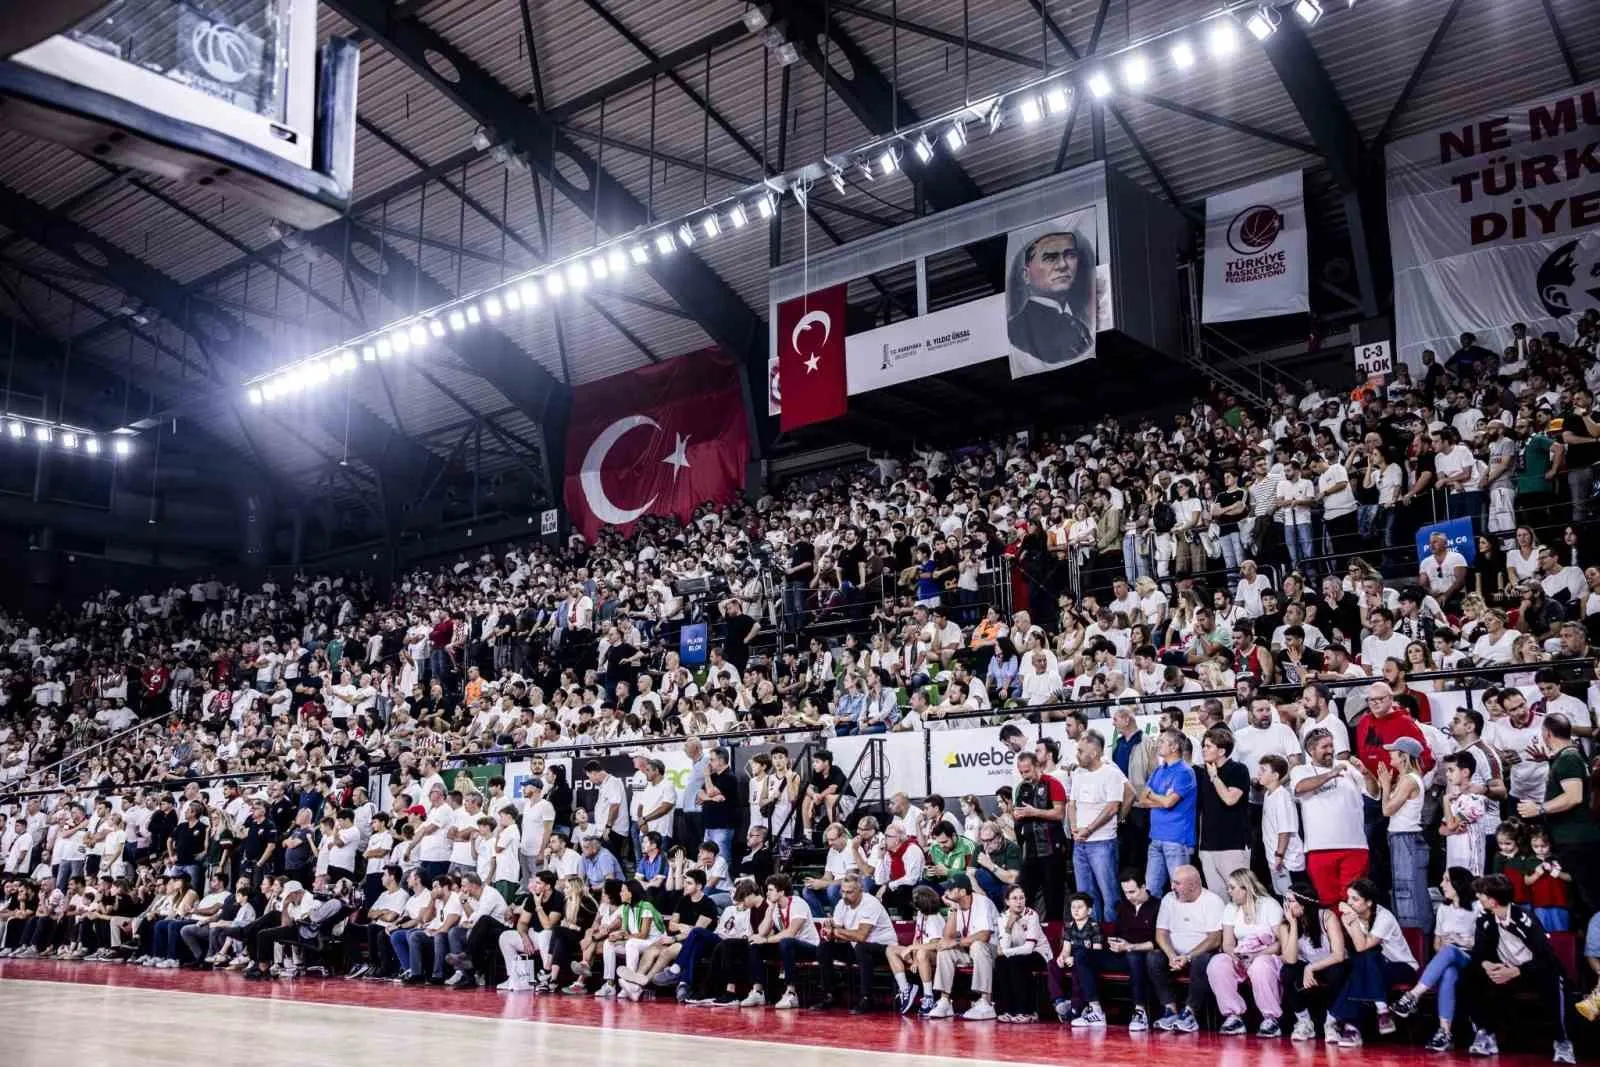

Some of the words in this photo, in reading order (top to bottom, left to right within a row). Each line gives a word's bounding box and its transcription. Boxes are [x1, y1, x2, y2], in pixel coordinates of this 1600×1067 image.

[1439, 116, 1512, 164] NE
[1226, 249, 1286, 271] TÜRKİYE
[1363, 344, 1383, 359] C-3
[960, 746, 1016, 767] webe
